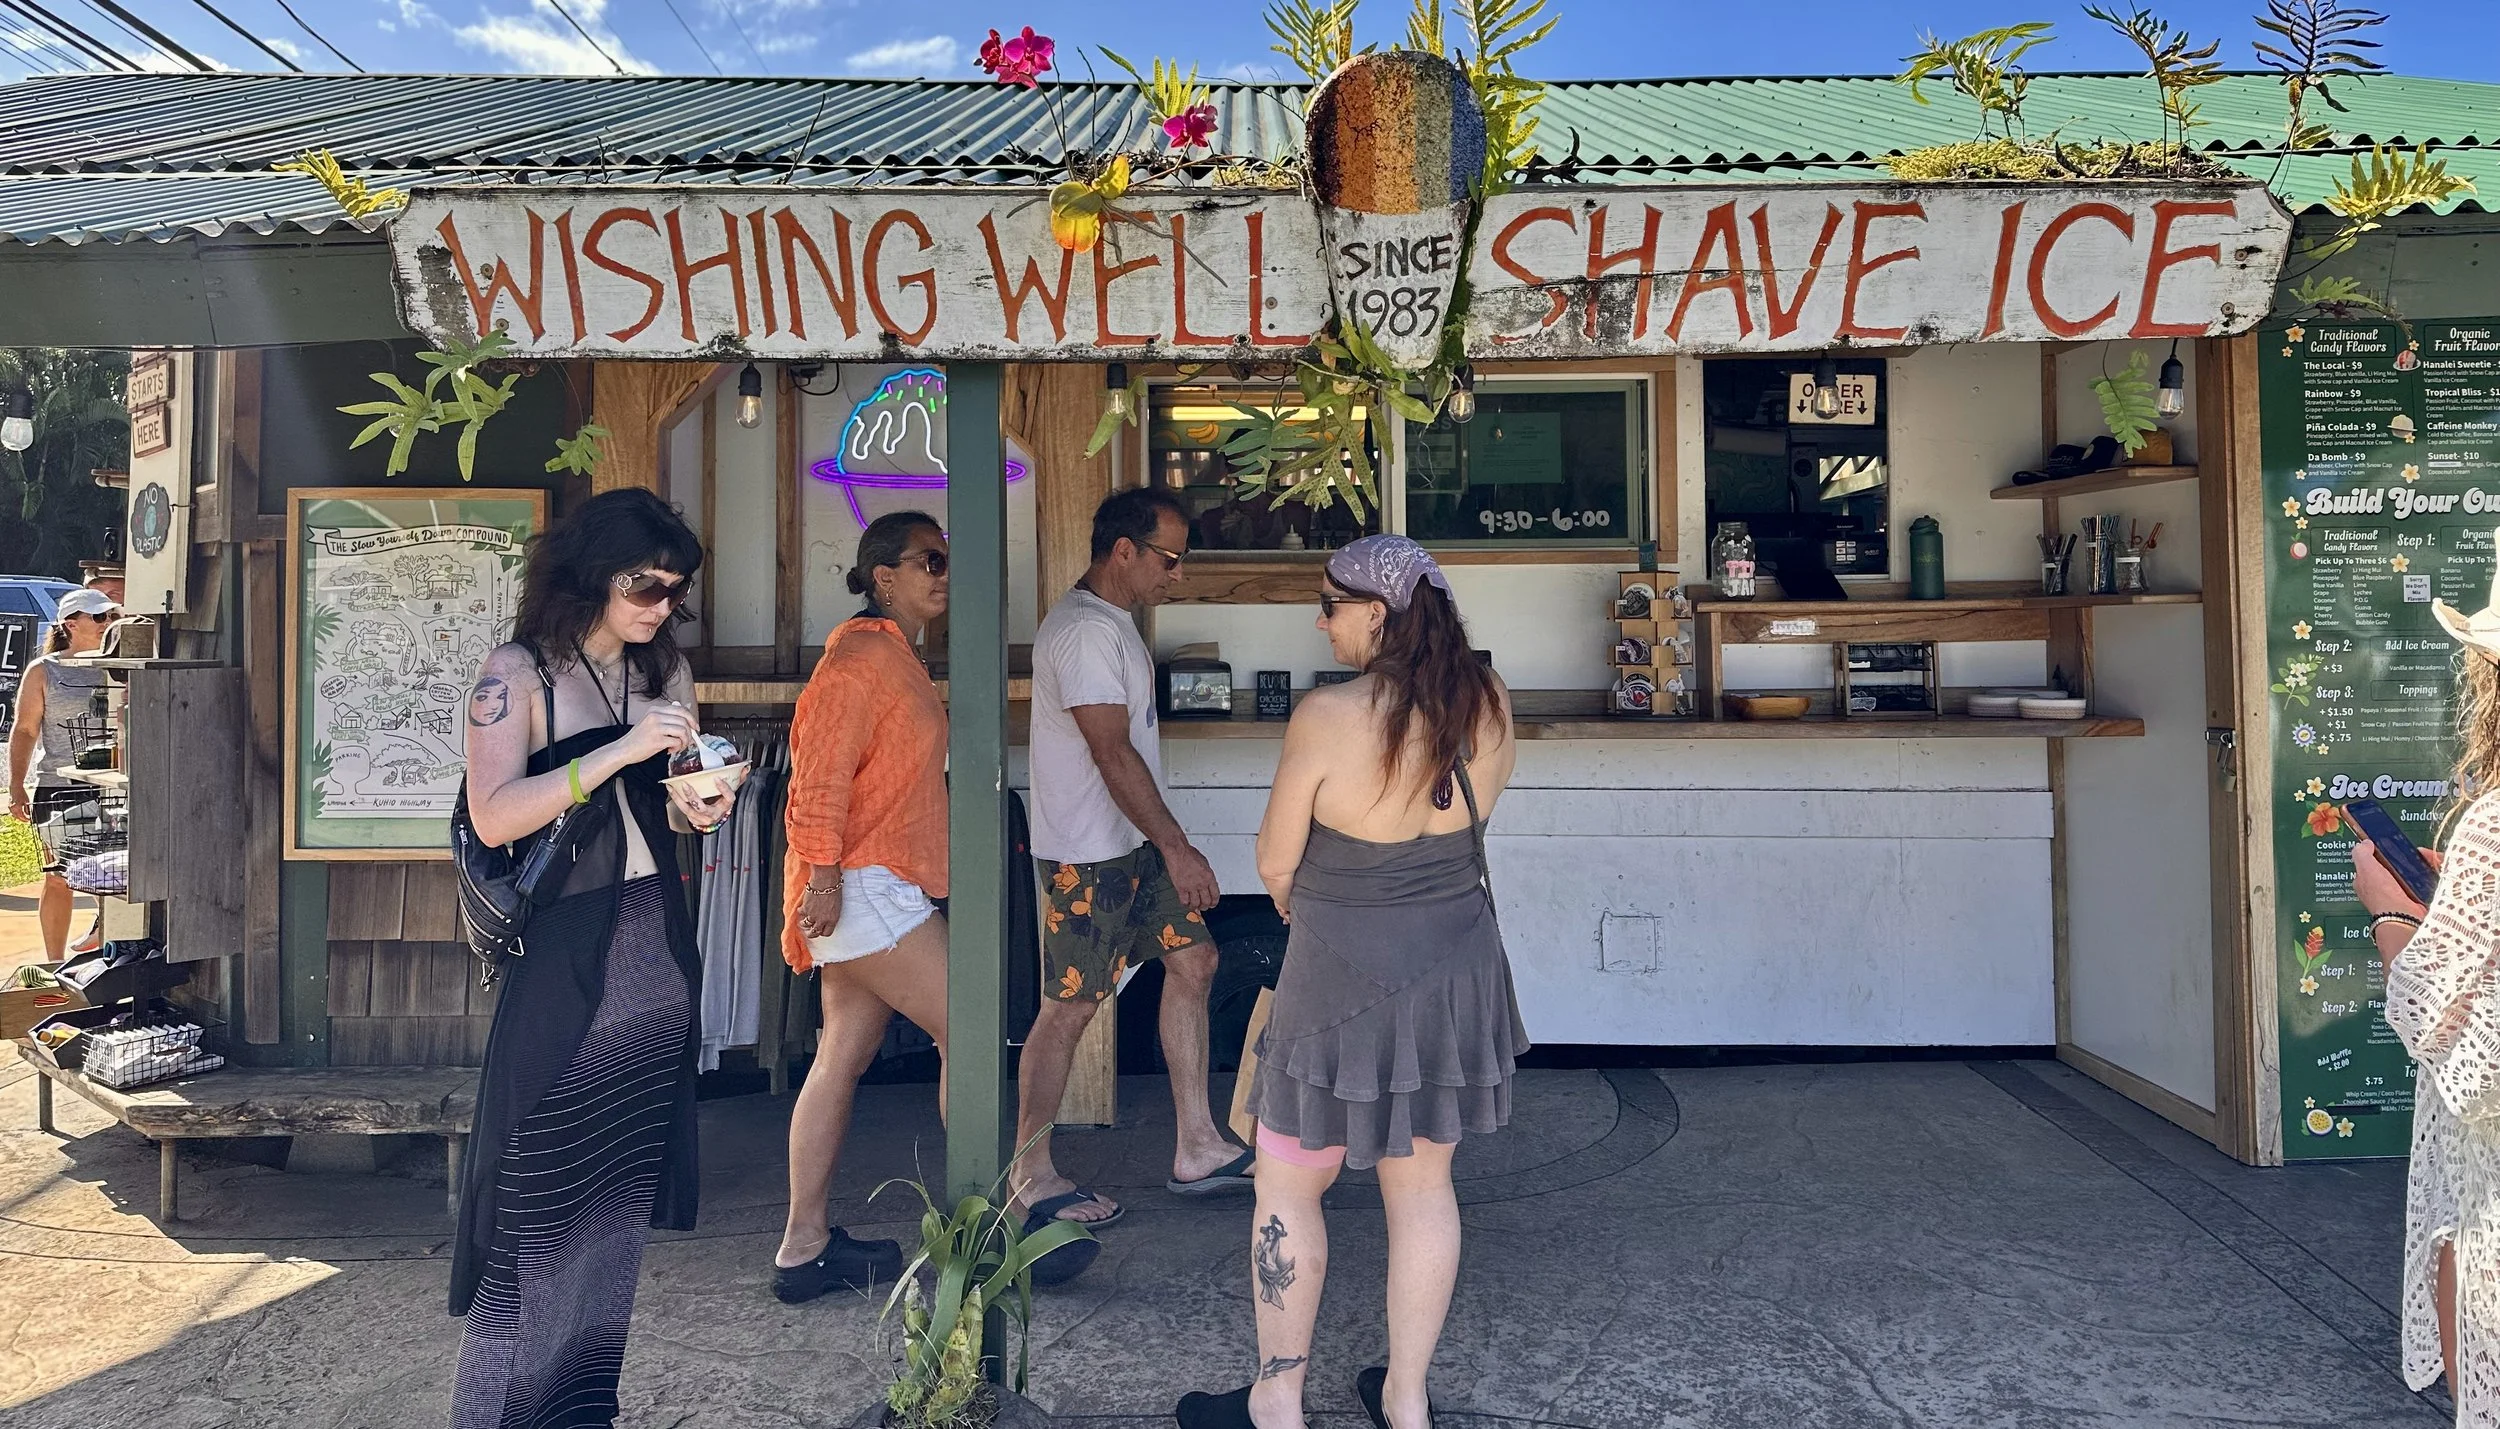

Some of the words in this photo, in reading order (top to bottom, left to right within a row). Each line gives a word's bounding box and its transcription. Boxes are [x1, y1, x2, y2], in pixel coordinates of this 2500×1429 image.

[1340, 232, 1456, 280] SINCE
[434, 205, 938, 346] WISHING
[975, 205, 1315, 347] WELL
[1491, 199, 1929, 344] SHAVE
[1976, 199, 2240, 341] ICE
[1347, 286, 1442, 339] 1983
[2319, 329, 2379, 341] Traditional
[2450, 327, 2491, 342] Organic
[2310, 341, 2343, 356] Candy
[2346, 341, 2387, 352] Flavors
[2435, 340, 2461, 351] Fruit
[2304, 362, 2320, 370] The
[2322, 361, 2346, 370] Local
[2352, 361, 2363, 370] $9
[2423, 360, 2456, 369] Hanalei
[2457, 360, 2492, 369] Sweetie
[132, 373, 164, 400] STARTS
[1803, 383, 1863, 398] OER
[2305, 389, 2344, 398] Rainbow
[2350, 389, 2361, 398] $9
[2425, 388, 2460, 398] Tropical
[2461, 388, 2482, 396] Bliss
[2306, 422, 2326, 431] Piña
[2327, 422, 2359, 431] Colada
[2366, 422, 2377, 431] $9
[2427, 421, 2463, 430] Caffeine
[2464, 421, 2498, 431] Monkey
[137, 421, 160, 446] HERE
[2308, 453, 2320, 461] Da
[2321, 453, 2348, 461] Bomb
[2355, 452, 2366, 461] $9
[2463, 451, 2480, 460] $10
[143, 488, 158, 507] NO
[2306, 487, 2385, 515] Build
[2388, 487, 2460, 519] Your
[331, 541, 347, 553] THE
[351, 541, 375, 552] Slow
[377, 530, 419, 547] Yourself
[422, 529, 452, 540] Down
[456, 528, 508, 544] COMPOUND
[2324, 529, 2379, 540] Traditional
[136, 536, 161, 552] PLASTIC
[2397, 533, 2422, 550] Step
[2427, 533, 2436, 546] 1:
[2455, 541, 2475, 550] Fruit
[2324, 542, 2347, 554] Candy
[2349, 542, 2378, 551] Flavors
[2315, 557, 2332, 565] Pick
[2333, 557, 2344, 566] Up
[2378, 557, 2387, 565] $6
[2447, 556, 2464, 564] Pick
[2464, 556, 2476, 565] Up
[0, 625, 22, 669] E
[2315, 639, 2340, 655] Step
[2343, 639, 2353, 652] 2:
[2385, 640, 2403, 650] Add
[2405, 640, 2418, 650] Ice
[2421, 640, 2450, 650] Cream
[2331, 663, 2343, 674] $3
[2316, 685, 2341, 702] Step
[2344, 685, 2354, 698] 3:
[2399, 684, 2438, 697] Toppings
[2327, 706, 2354, 717] $1.50
[2335, 719, 2347, 730] $1
[335, 753, 361, 762] PARKING
[2329, 774, 2369, 799] Ice
[2372, 774, 2449, 799] Cream
[373, 799, 396, 807] KUHIO
[400, 799, 432, 807] HIGHWAY
[2316, 841, 2347, 849] Cookie
[2315, 872, 2349, 880] Hanalei
[2343, 926, 2359, 938] Ice
[2320, 964, 2344, 980] Step
[2348, 963, 2356, 976] 1:
[2322, 1000, 2345, 1016] Step
[2348, 1000, 2358, 1012] 2:
[2317, 1056, 2330, 1067] Add
[2330, 1048, 2352, 1061] Waffle
[2333, 1058, 2350, 1071] $2.00
[2365, 1076, 2384, 1086] $.75
